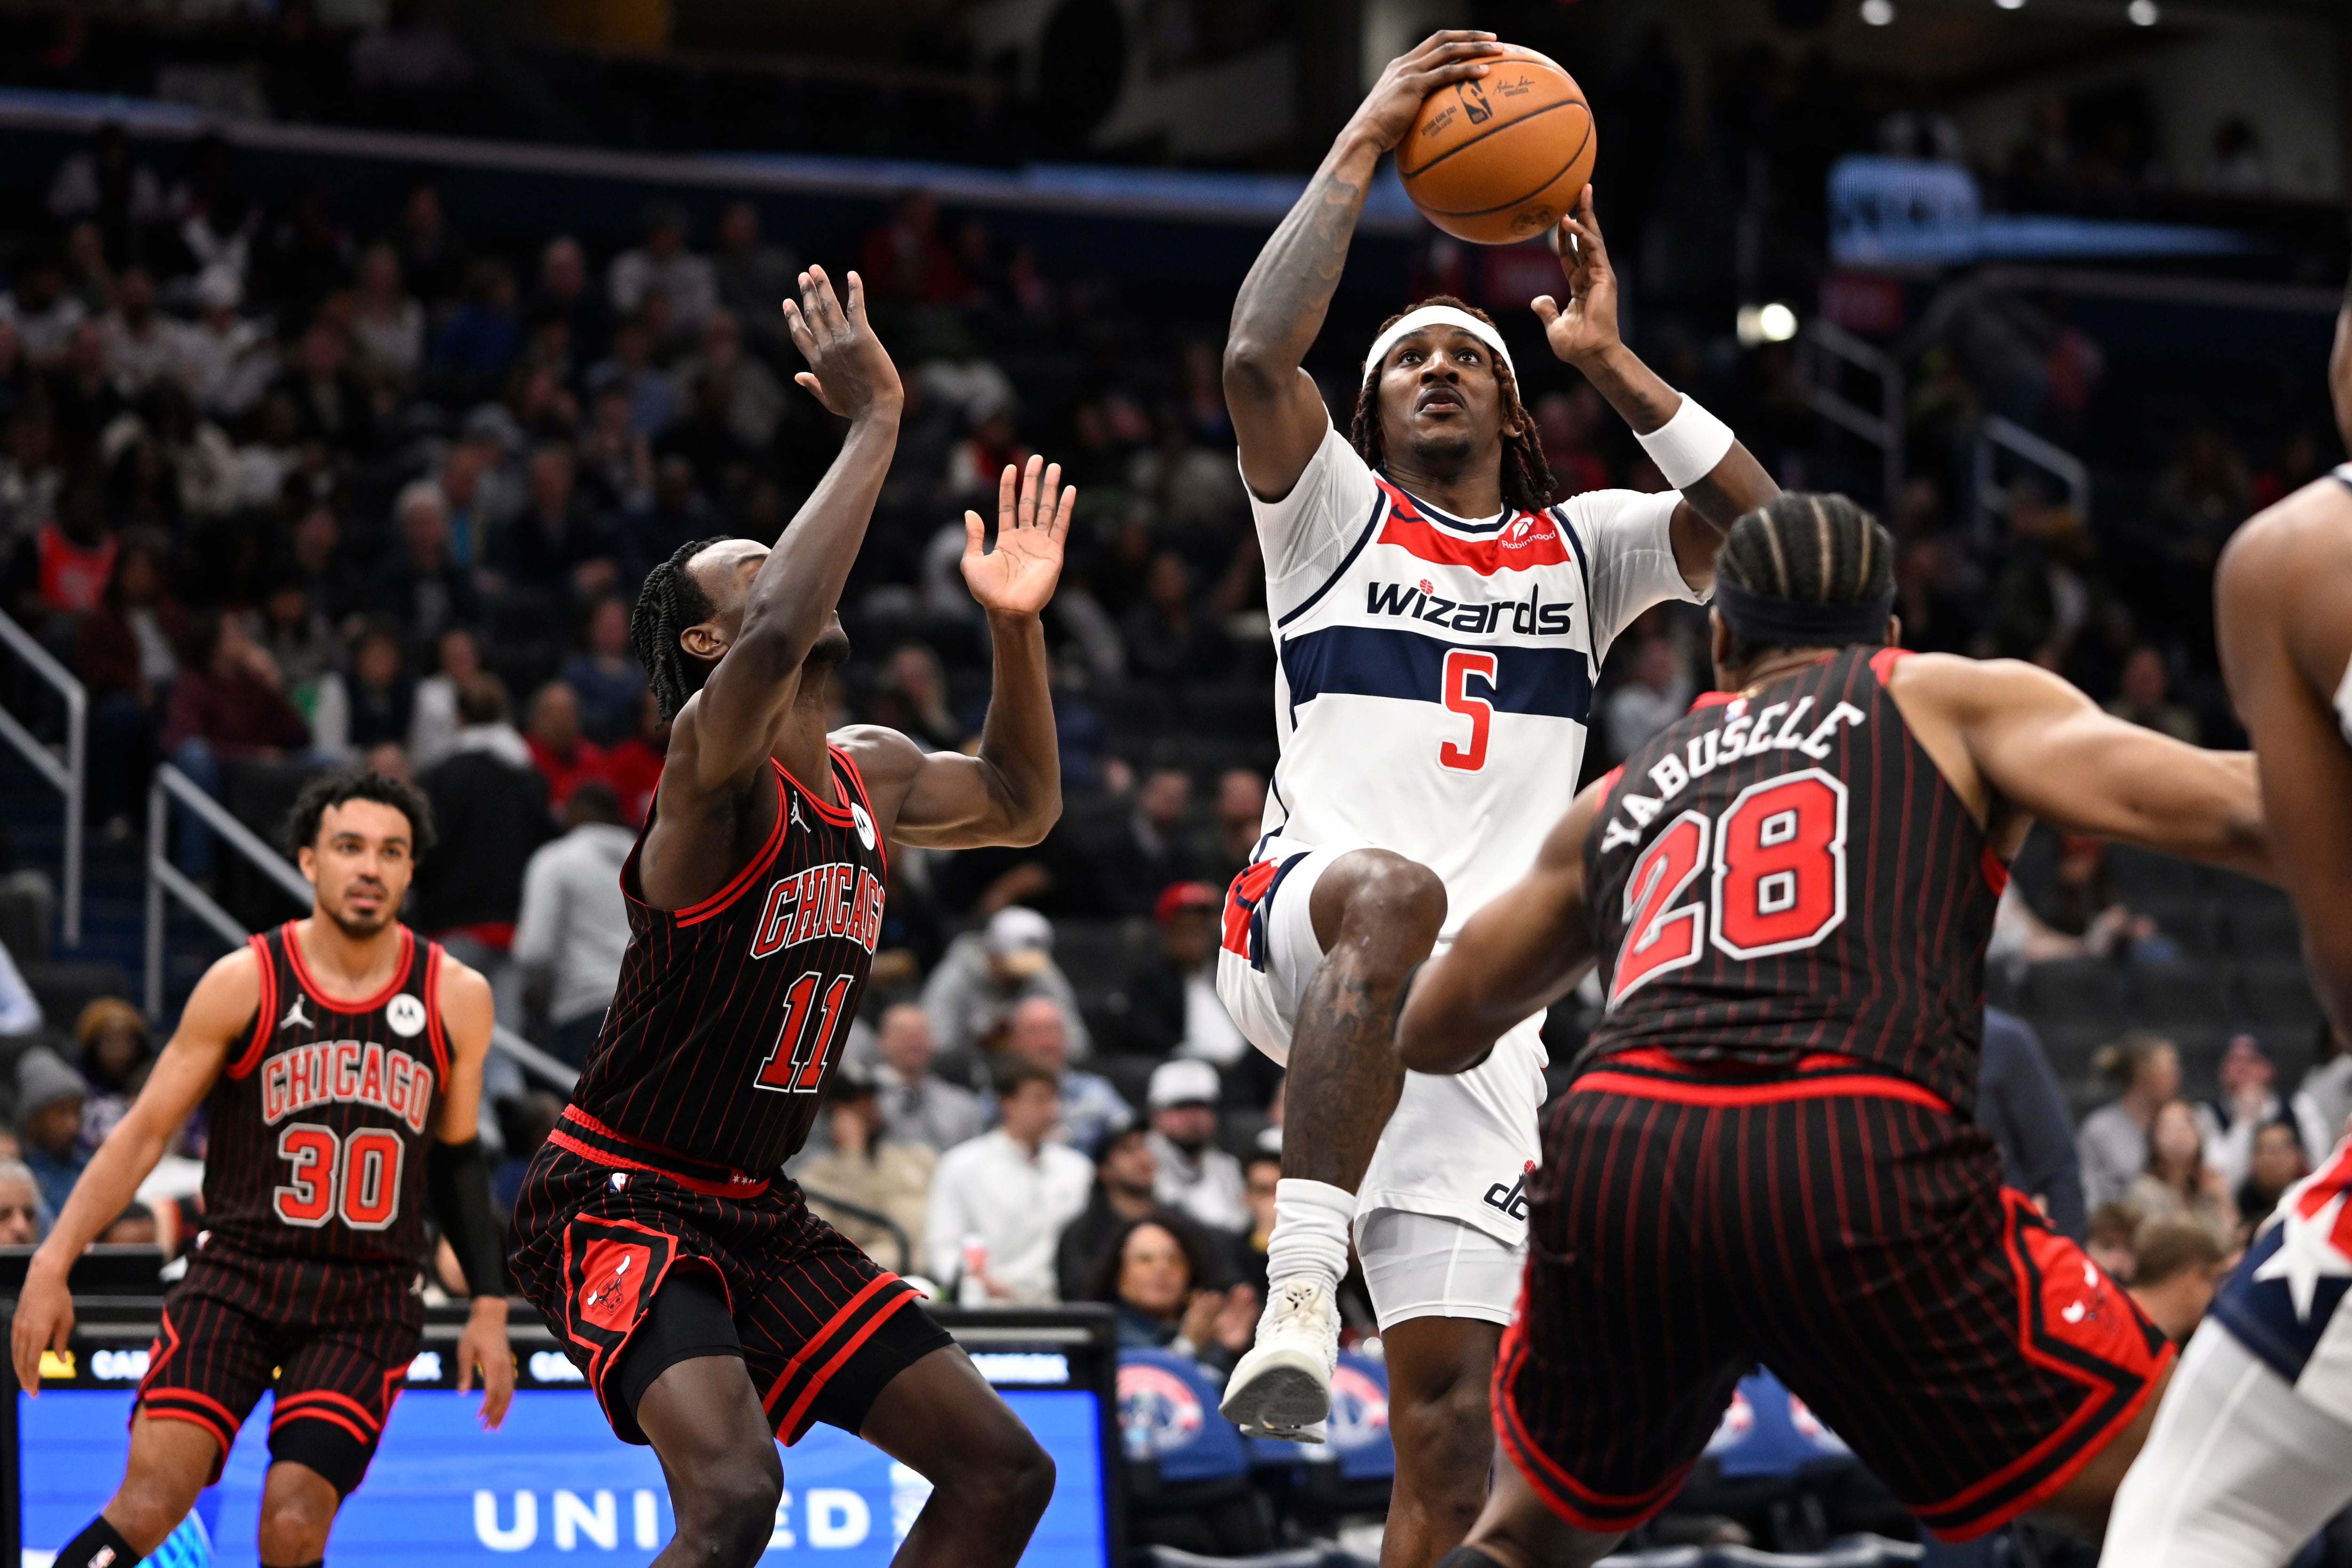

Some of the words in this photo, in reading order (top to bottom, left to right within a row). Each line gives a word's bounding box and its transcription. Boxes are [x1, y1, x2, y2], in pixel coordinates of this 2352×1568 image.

[1502, 530, 1556, 549] Robinhood
[1367, 578, 1573, 635] wizards
[1437, 648, 1498, 775] 5
[1600, 696, 1866, 854] YABUSELE
[1605, 768, 1849, 1016] 28
[754, 971, 854, 1093] 11
[262, 1039, 434, 1135] CHICAGO
[273, 1122, 405, 1230] 30
[474, 1488, 871, 1552] UNID
